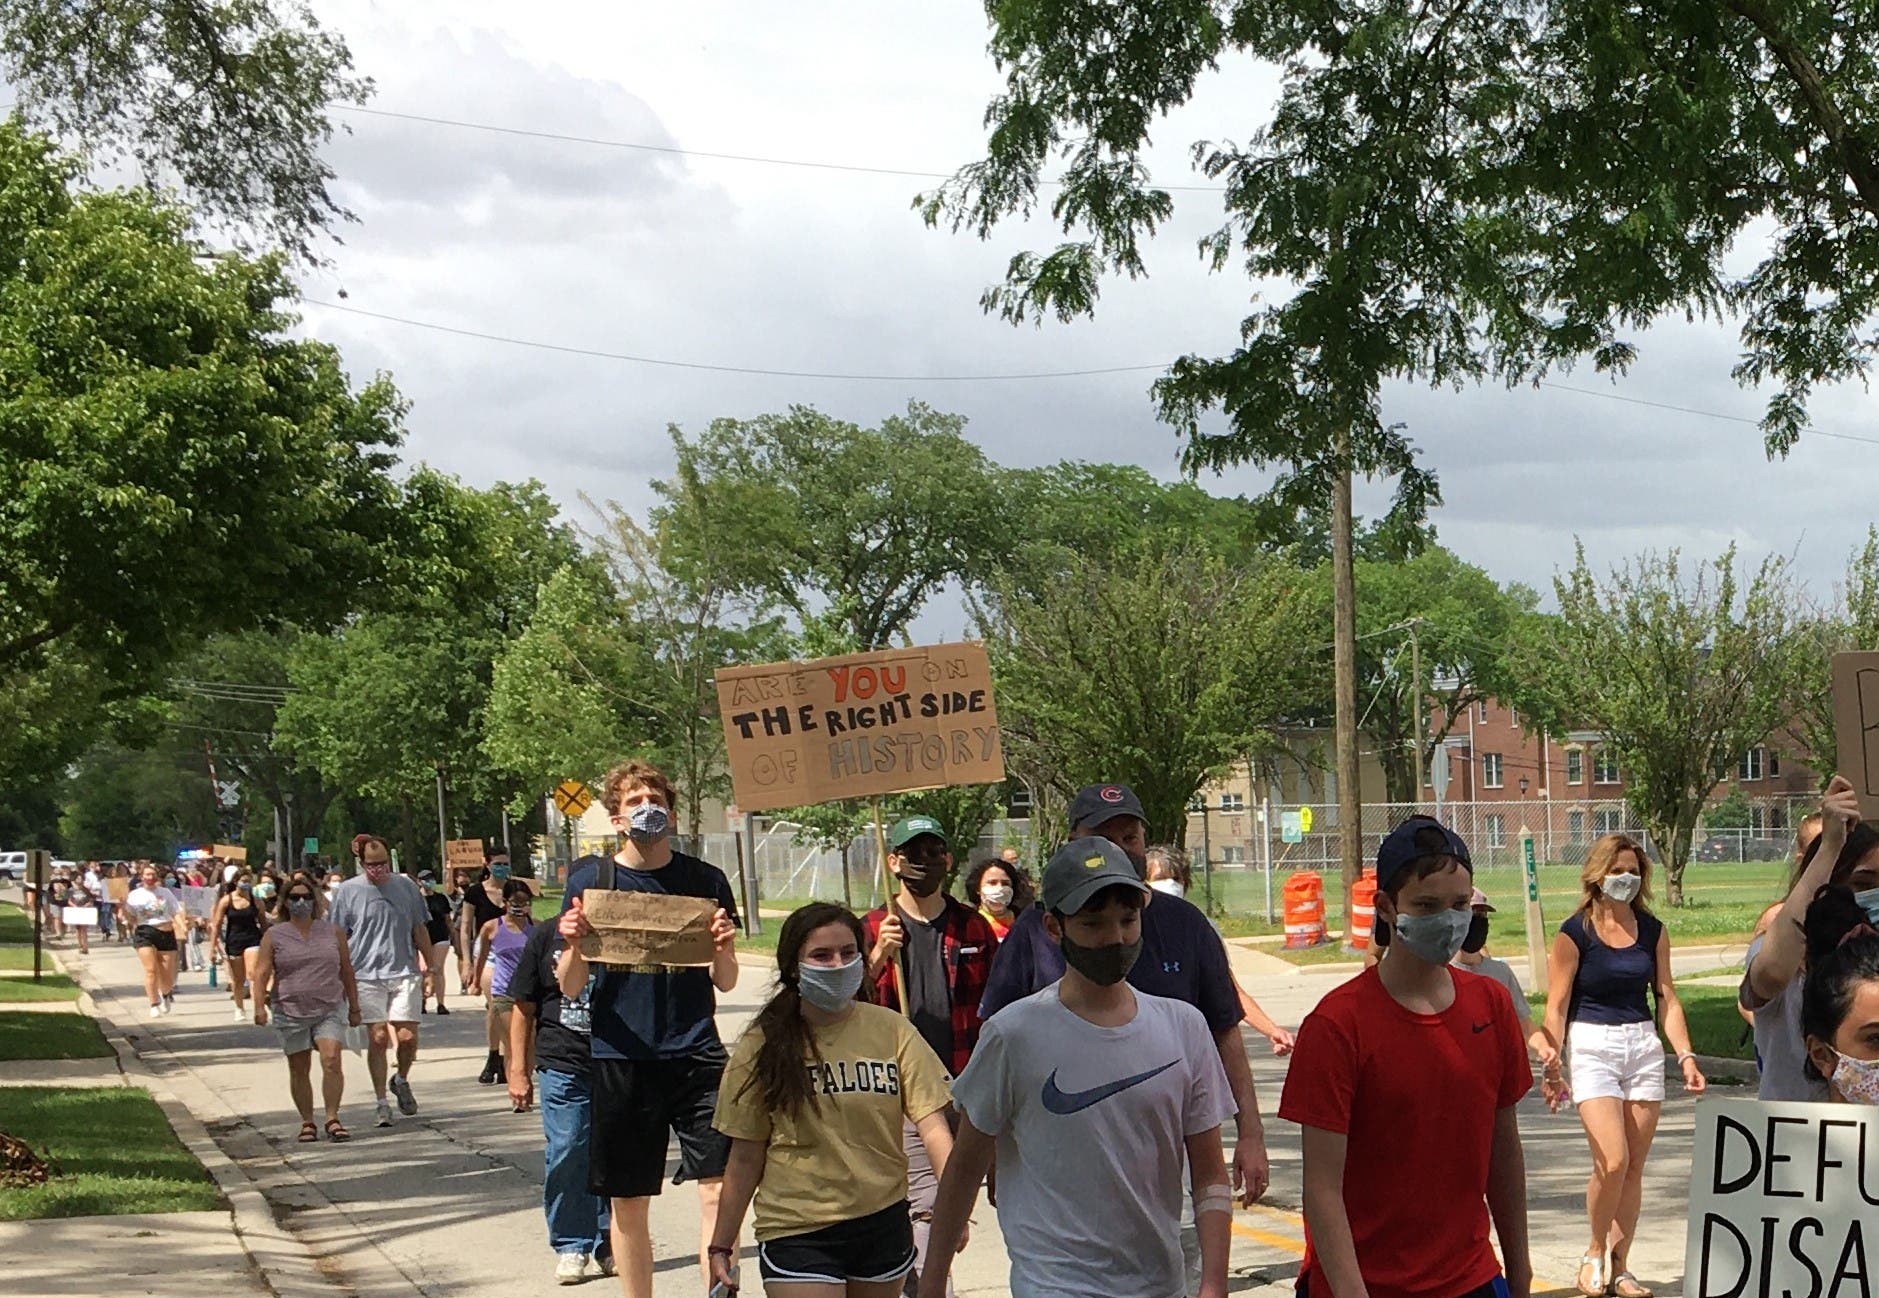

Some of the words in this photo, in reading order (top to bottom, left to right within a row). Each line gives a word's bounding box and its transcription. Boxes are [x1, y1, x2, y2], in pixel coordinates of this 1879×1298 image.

[732, 672, 808, 706] ARE
[827, 665, 906, 703] YOU
[921, 658, 969, 683] ON
[732, 704, 818, 740] THE
[825, 692, 913, 738] RIGHT
[920, 689, 986, 718] SIDE
[751, 749, 798, 786] OF
[828, 725, 998, 780] HISTORY
